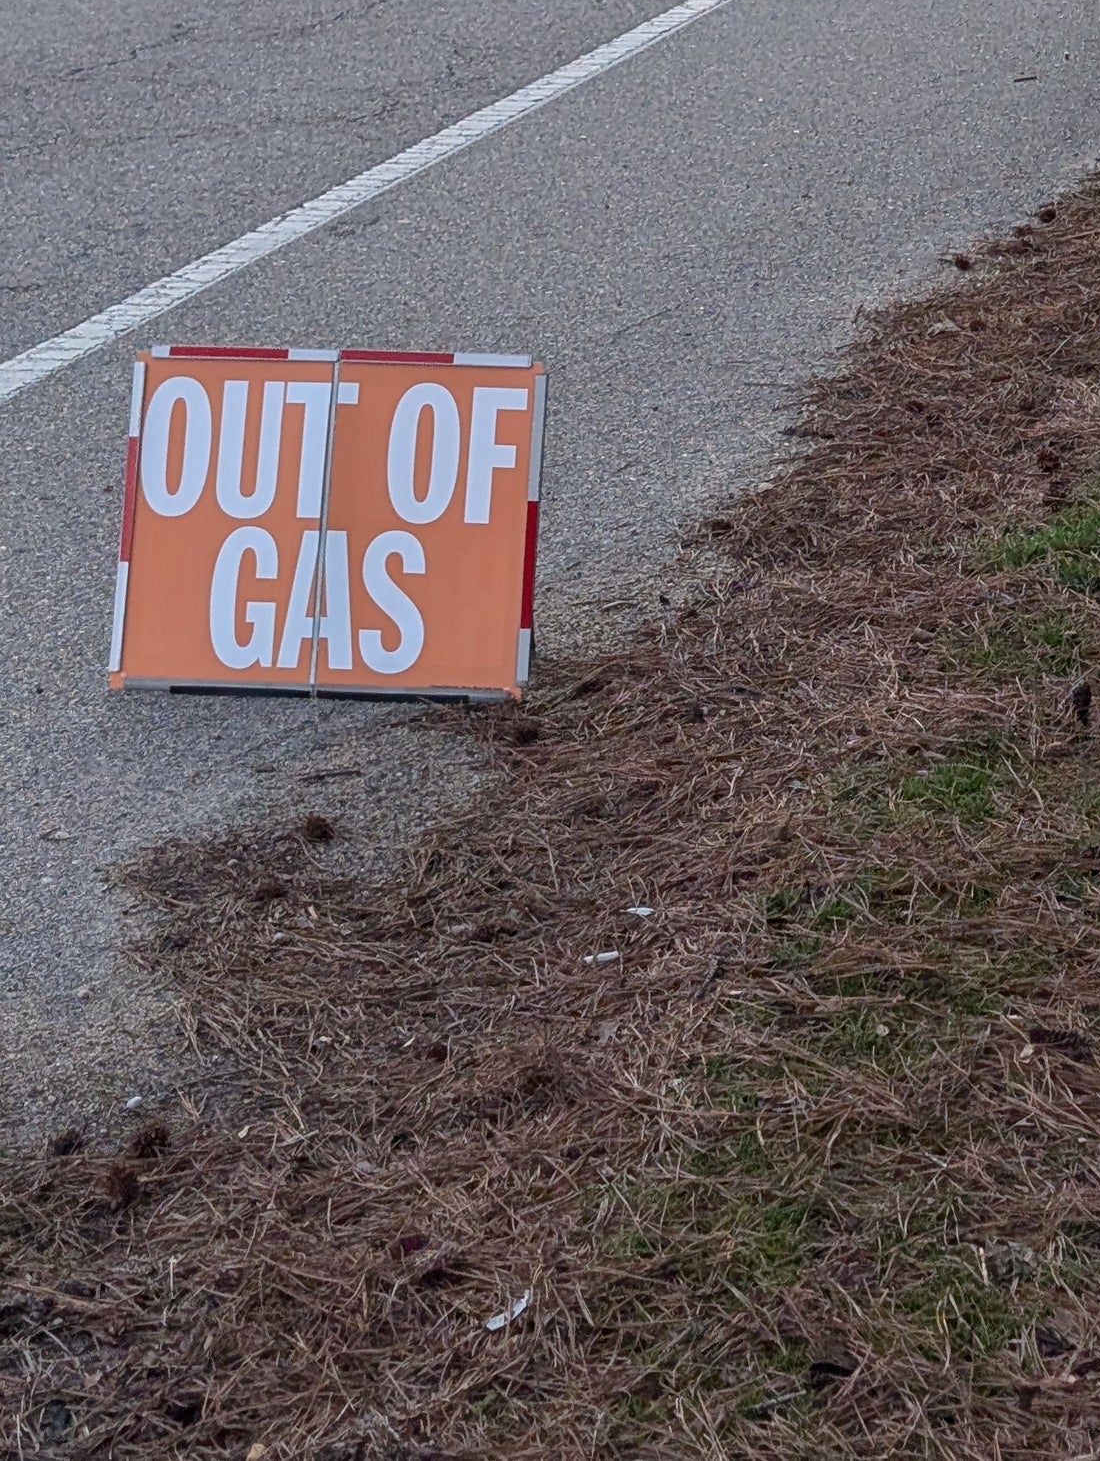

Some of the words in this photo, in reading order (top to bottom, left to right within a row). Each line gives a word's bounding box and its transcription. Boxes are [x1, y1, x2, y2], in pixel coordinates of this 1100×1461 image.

[141, 376, 360, 519] OUT
[387, 382, 528, 524] OF
[209, 526, 426, 674] GAS
